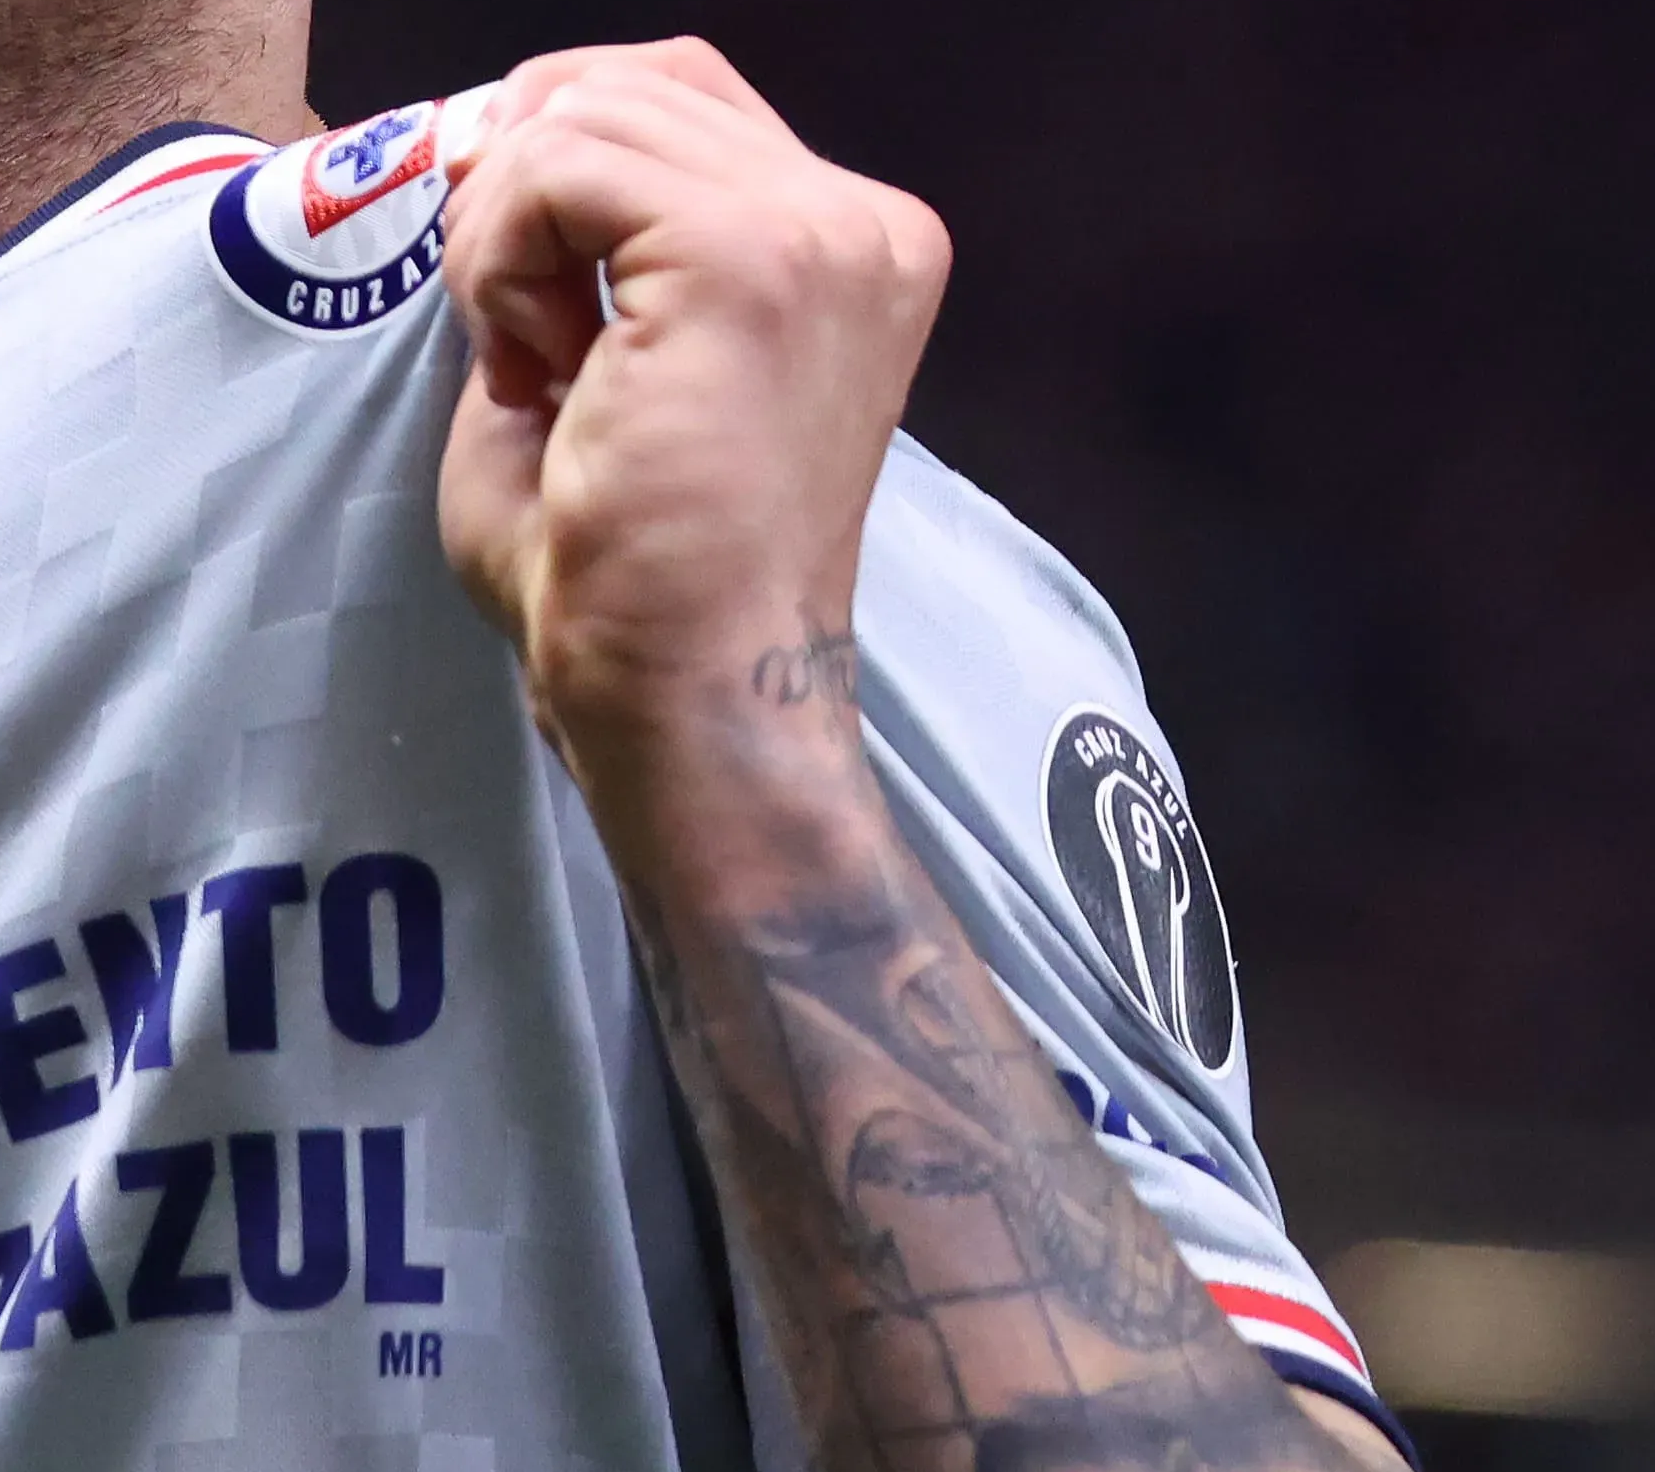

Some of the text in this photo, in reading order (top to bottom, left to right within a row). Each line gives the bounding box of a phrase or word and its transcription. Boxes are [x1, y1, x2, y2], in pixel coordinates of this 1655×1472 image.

[286, 211, 447, 322] CRUZ AZ
[1074, 726, 1188, 840] CRUZ AZUL
[1130, 801, 1162, 871] 9
[0, 1126, 444, 1352] AZUL
[379, 1331, 442, 1378] MR
